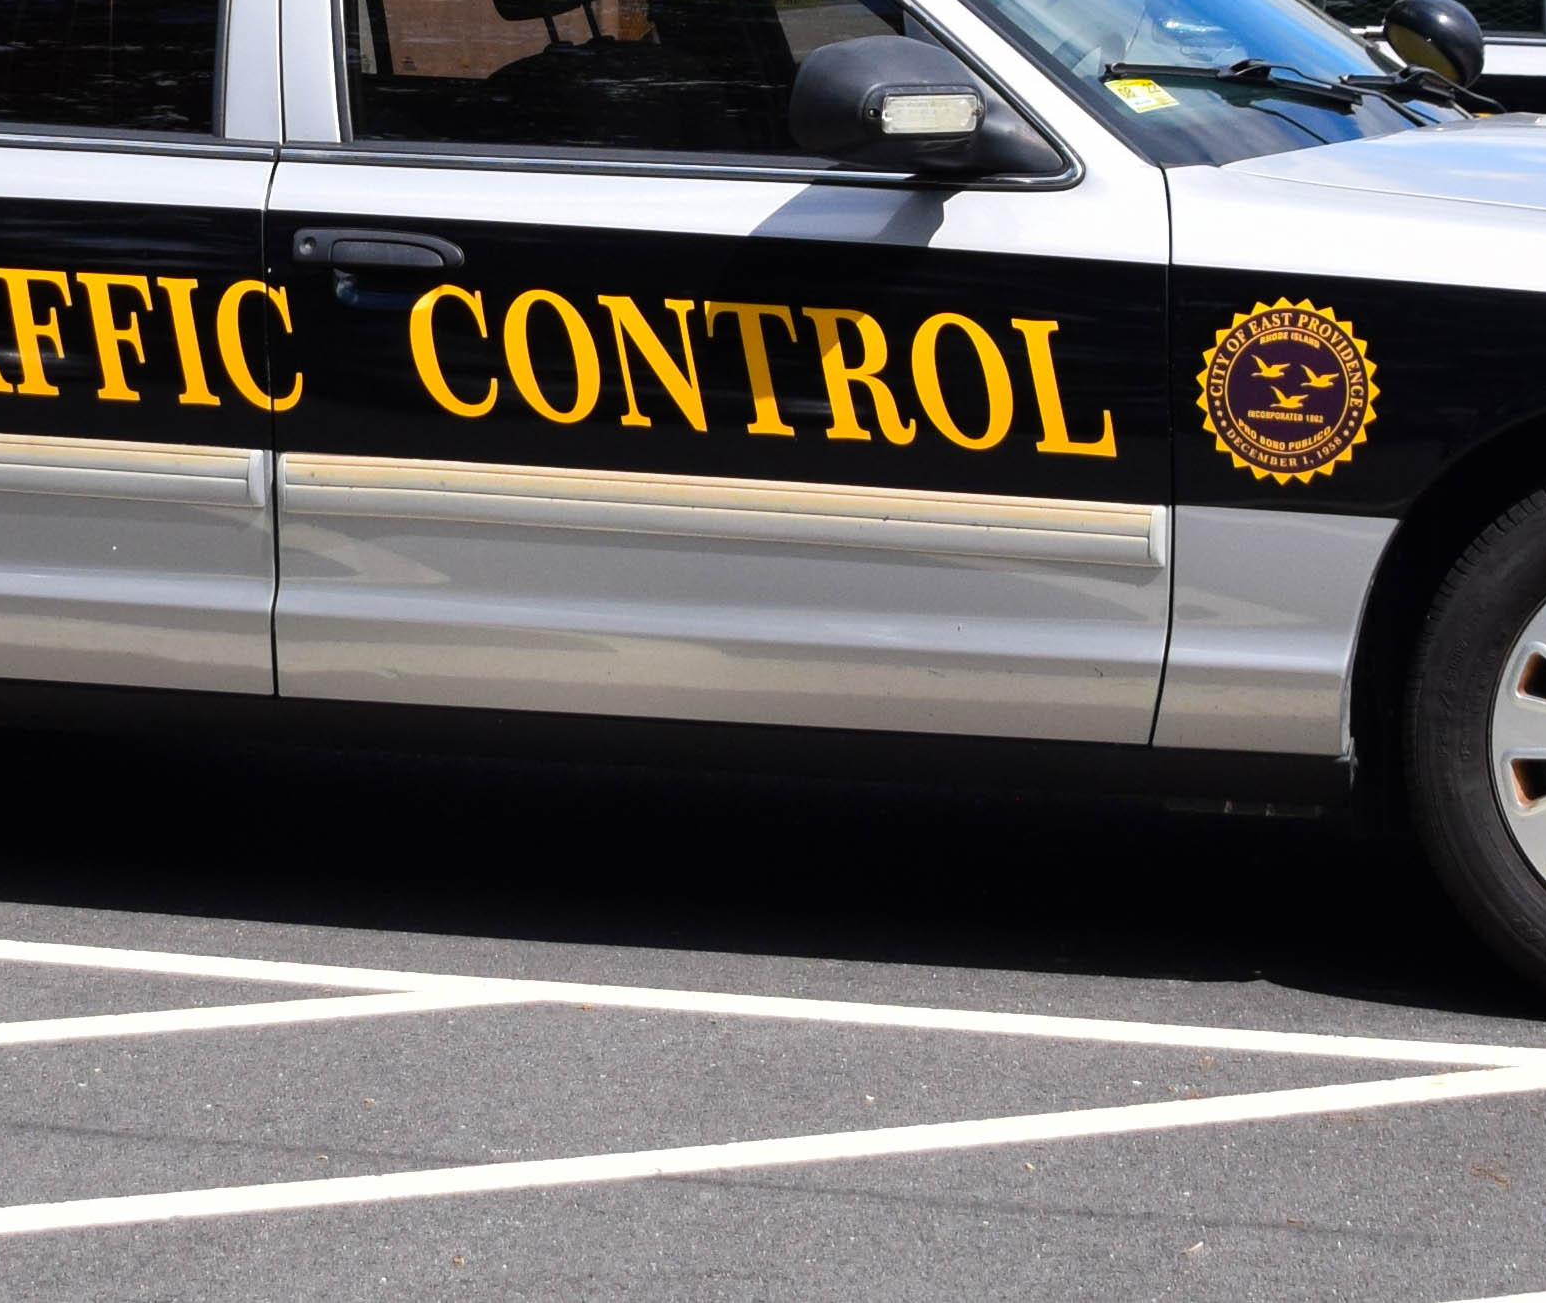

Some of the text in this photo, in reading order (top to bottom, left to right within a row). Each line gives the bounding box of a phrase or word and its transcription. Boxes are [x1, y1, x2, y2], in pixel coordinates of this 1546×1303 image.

[1259, 332, 1321, 350] RHODE ISLAND
[409, 283, 1117, 459] CONTROL
[1210, 312, 1364, 408] CITY OF EAST PROVIDENCE
[1247, 409, 1303, 422] INCORPORATED
[1226, 428, 1297, 467] DECEMBER
[1316, 436, 1343, 459] 1958
[1238, 418, 1332, 451] PRO BONO PUBLICO
